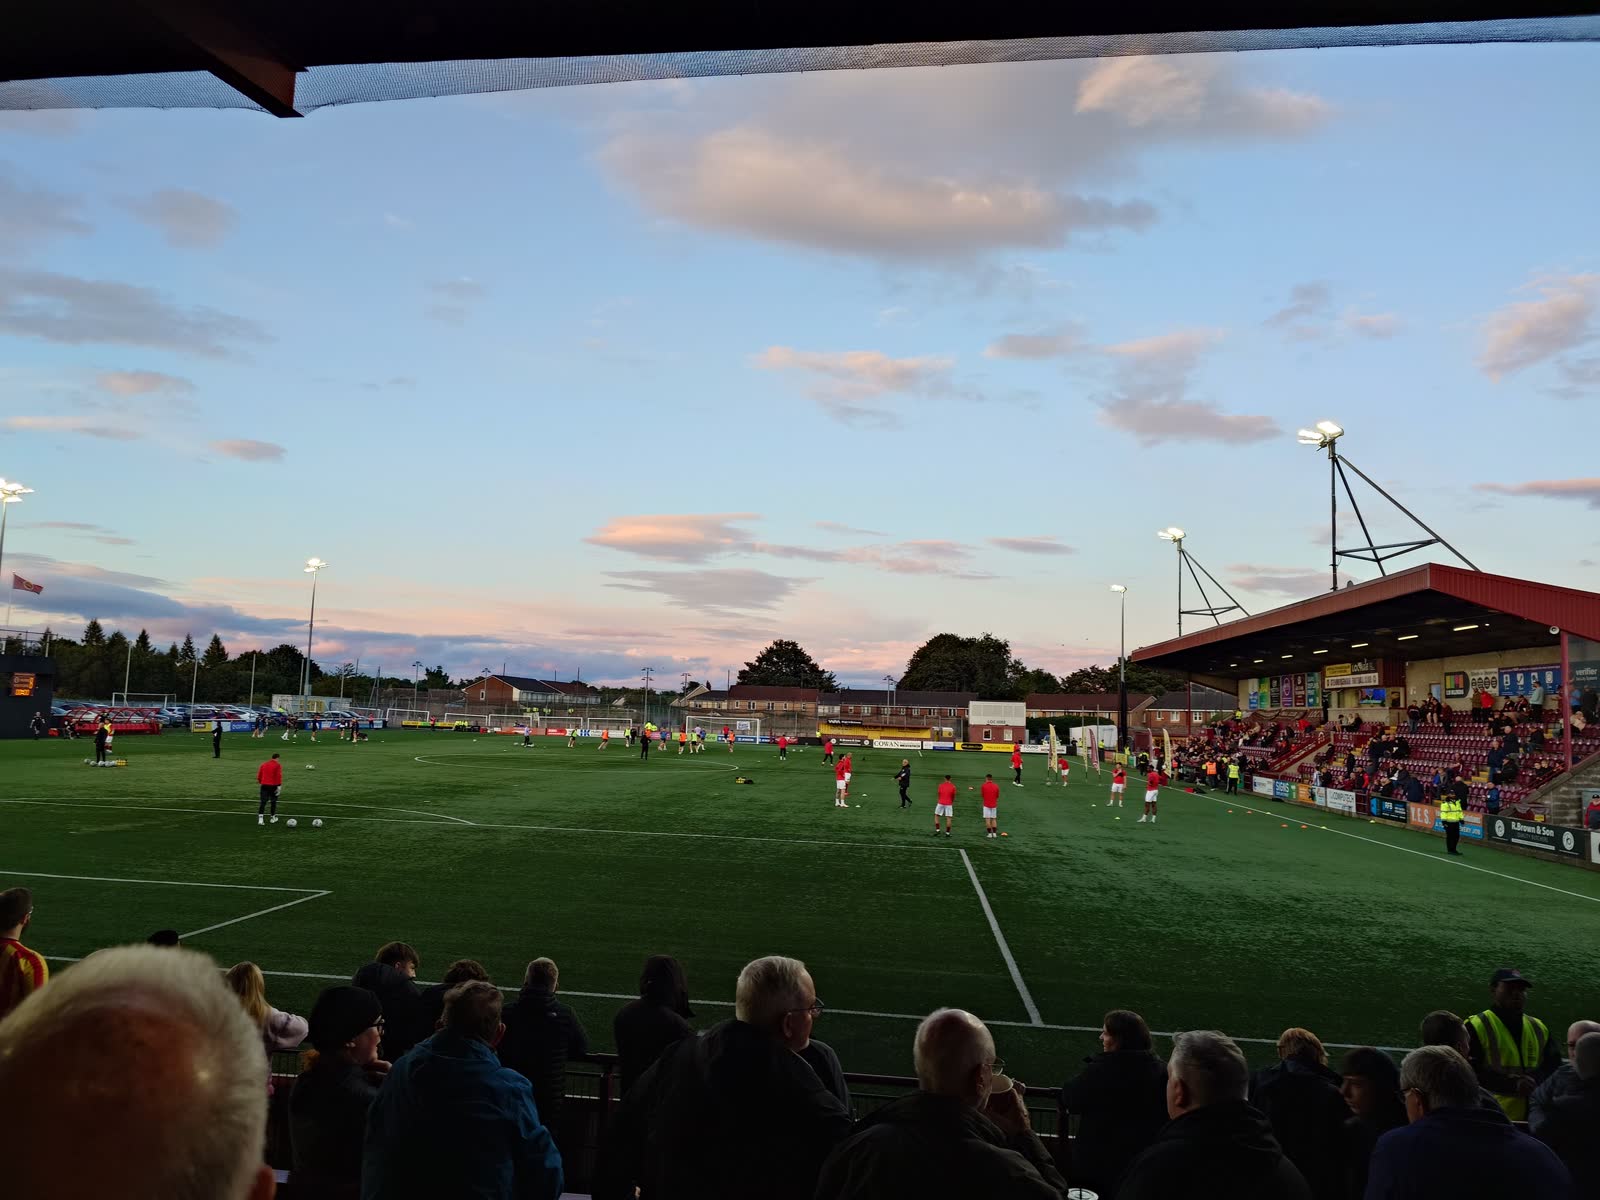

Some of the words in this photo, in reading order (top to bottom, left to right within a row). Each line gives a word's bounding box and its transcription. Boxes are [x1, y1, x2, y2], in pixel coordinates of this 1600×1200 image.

[1511, 821, 1535, 834] R.Brown
[1536, 825, 1542, 834] &
[1542, 826, 1555, 837] Son
